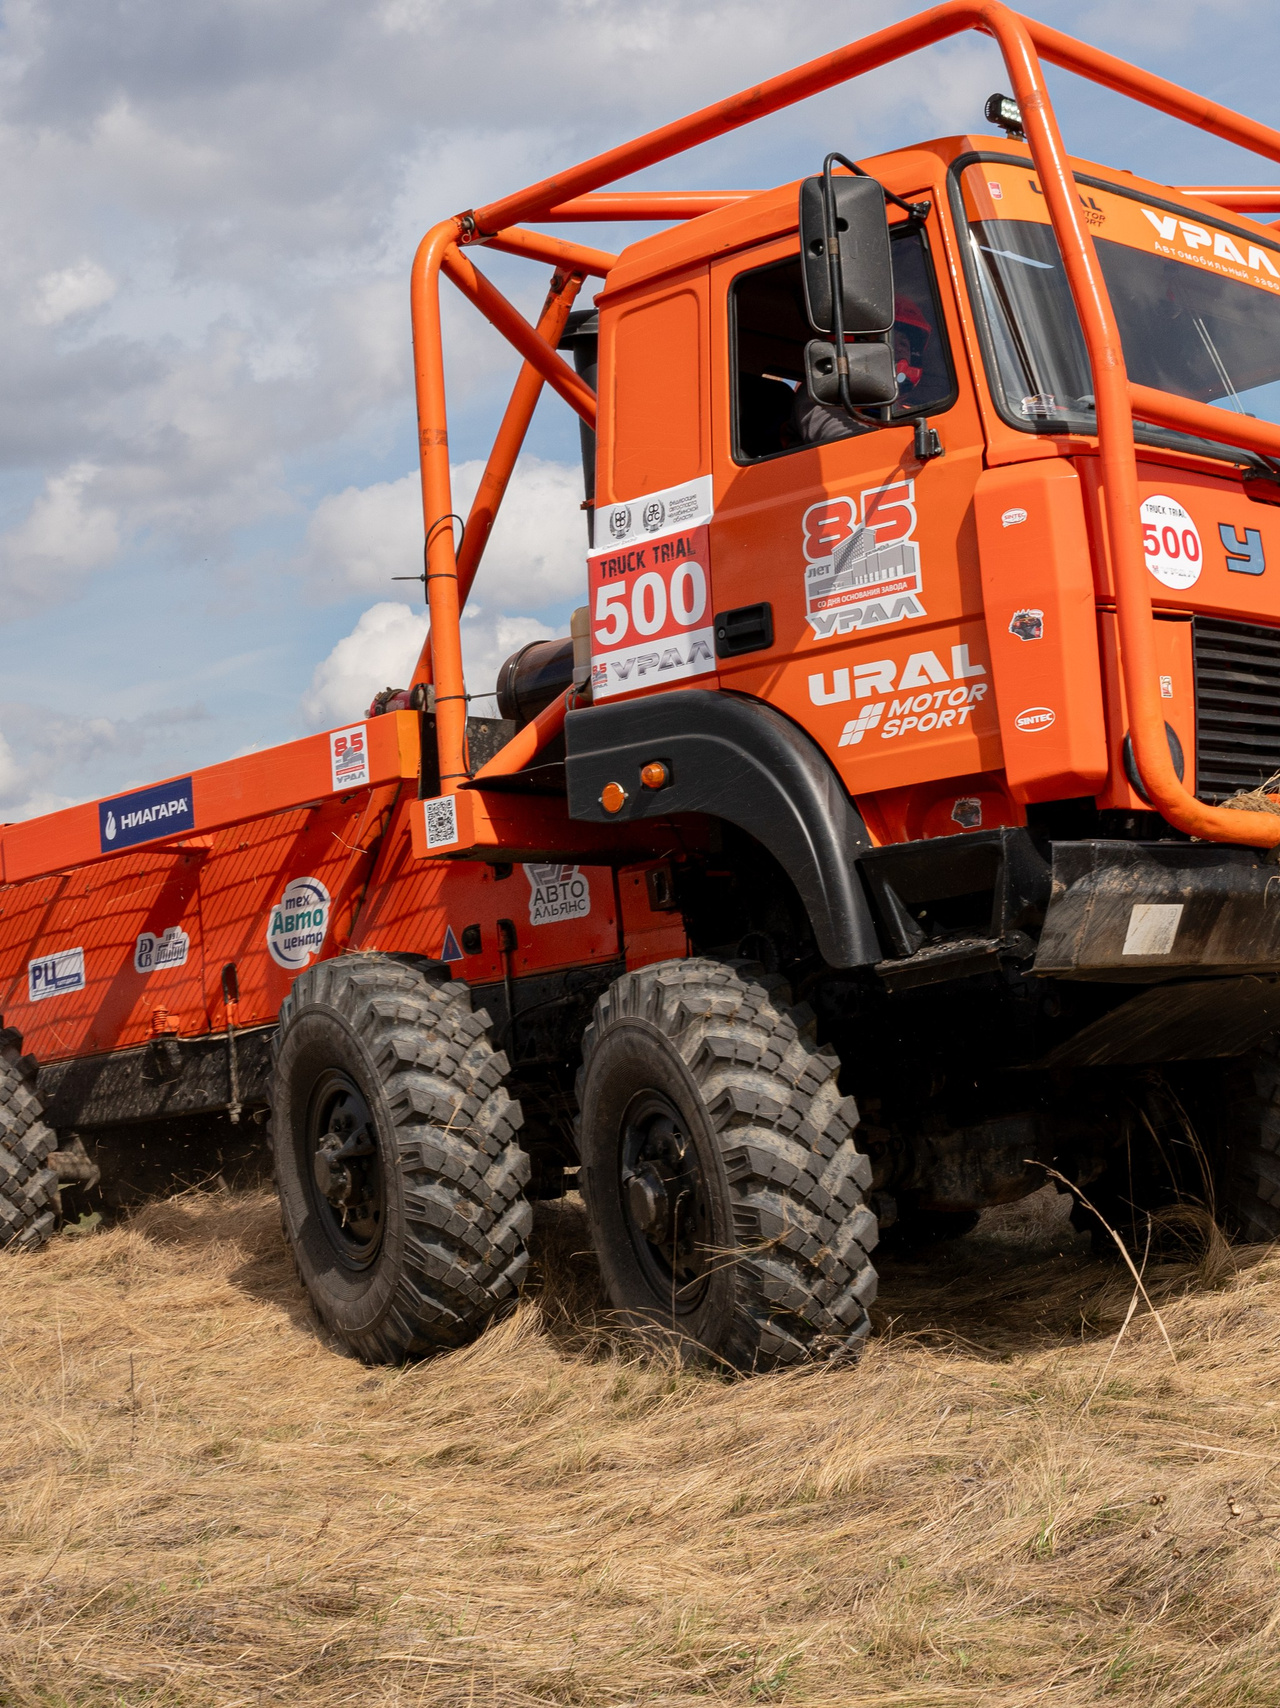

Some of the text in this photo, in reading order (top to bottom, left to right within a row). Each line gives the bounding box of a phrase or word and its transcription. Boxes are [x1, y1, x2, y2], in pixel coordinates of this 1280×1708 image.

[1028, 180, 1103, 212] UL
[1140, 208, 1280, 278] УРАЛ
[1154, 241, 1249, 279] Автомобильный
[804, 480, 915, 561] 85
[1145, 504, 1187, 519] TRUCK TRIAL
[600, 550, 646, 579] TRUCK
[652, 537, 696, 566] TRIAL
[1142, 523, 1199, 562] 500
[807, 564, 831, 578] лет
[594, 561, 707, 646] 500
[817, 581, 908, 608] СО ДНЯ ОСНОВАНИЯ ЗАВОДА
[809, 595, 920, 636] УРАЛ
[610, 640, 714, 681] УРАЛ
[808, 643, 987, 706] URAL
[887, 683, 988, 718] MOTOR
[880, 705, 976, 739] SPORT
[1017, 712, 1053, 727] SINTEC
[334, 732, 364, 757] 85
[336, 771, 366, 783] УРАЛ
[121, 798, 188, 829] НИАГАРА
[285, 895, 310, 910] тех
[533, 880, 584, 906] АВТО
[271, 908, 324, 936] Авто
[534, 899, 586, 920] АЛЬЯНС
[284, 932, 323, 951] центр
